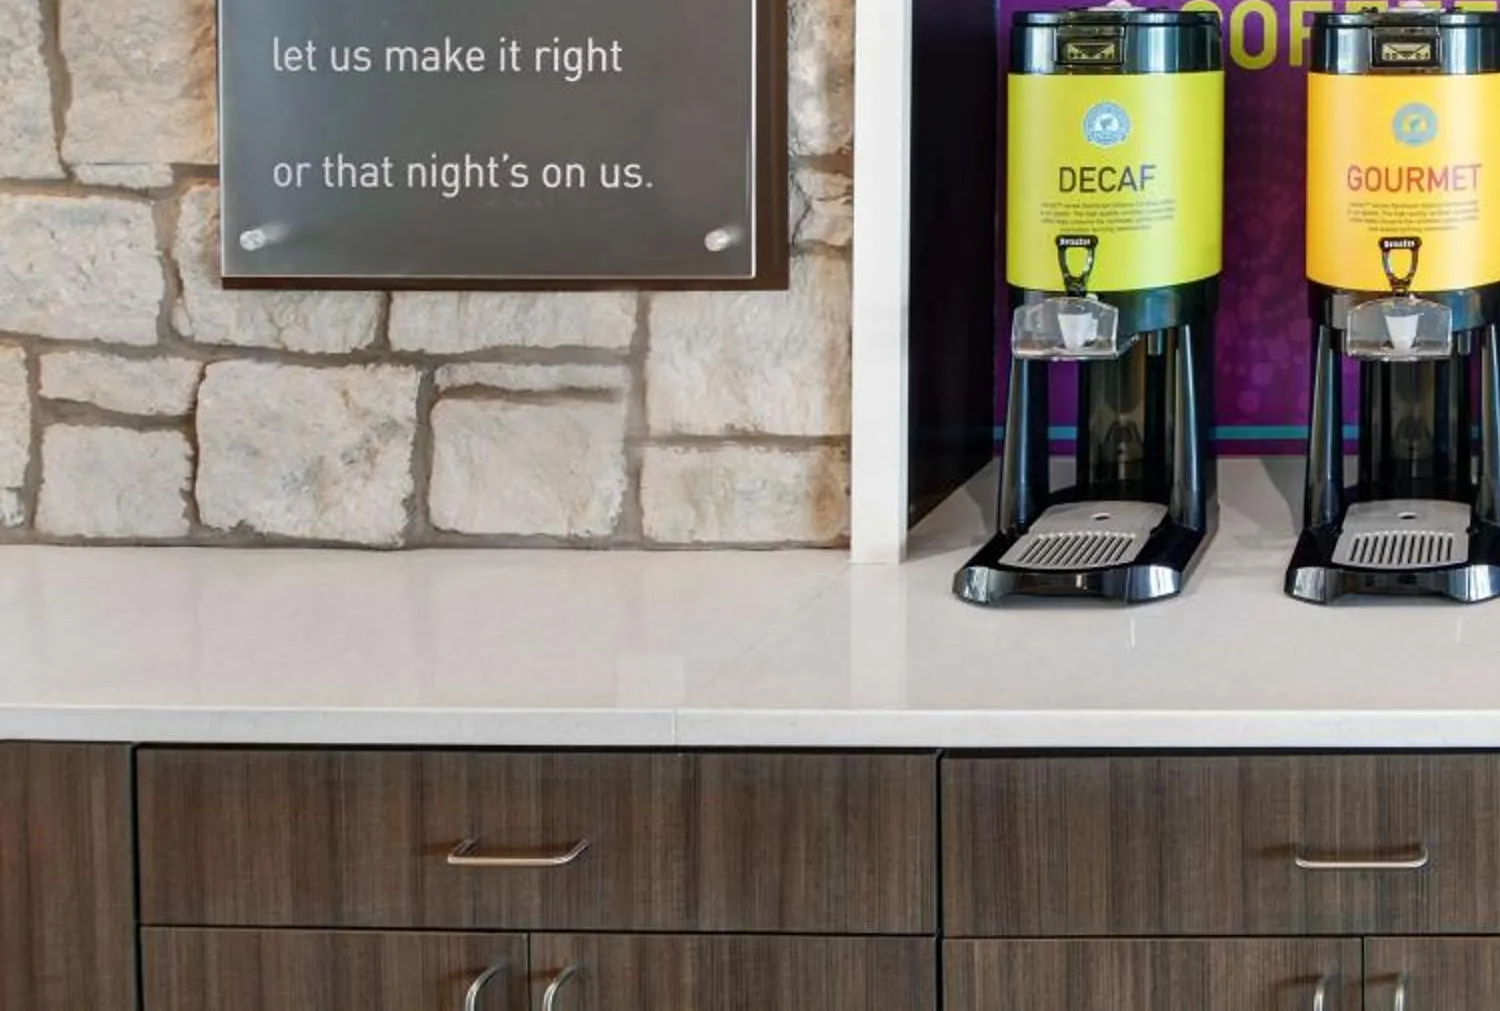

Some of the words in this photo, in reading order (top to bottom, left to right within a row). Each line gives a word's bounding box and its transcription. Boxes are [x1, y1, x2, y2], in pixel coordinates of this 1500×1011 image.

[273, 37, 317, 72] let
[330, 46, 372, 72] us
[385, 37, 486, 73] make
[499, 37, 521, 72] it
[535, 37, 623, 83] right
[273, 162, 312, 188] or
[322, 152, 394, 188] that
[407, 152, 529, 199] night's
[541, 162, 586, 189] on
[600, 163, 653, 189] us.
[1058, 164, 1157, 193] DECAF
[1346, 163, 1482, 194] GOURMET
